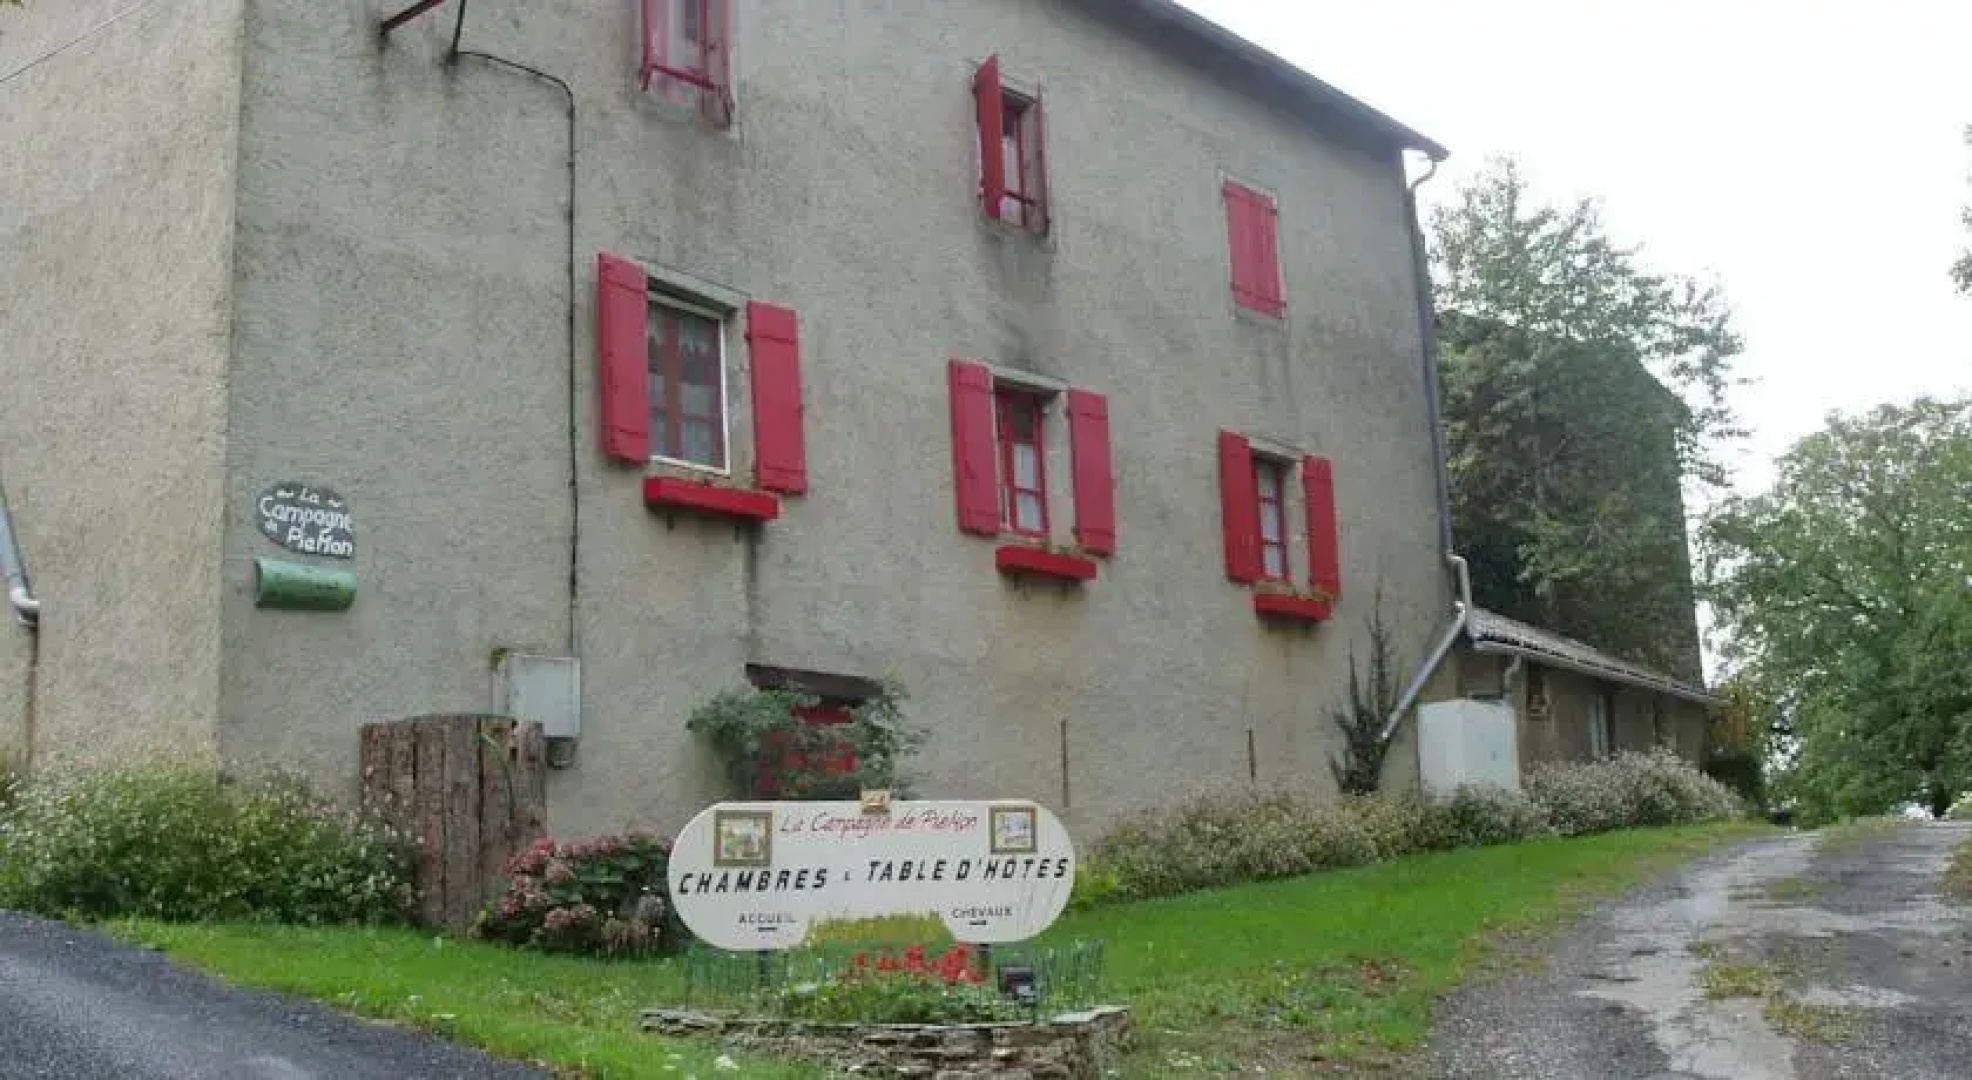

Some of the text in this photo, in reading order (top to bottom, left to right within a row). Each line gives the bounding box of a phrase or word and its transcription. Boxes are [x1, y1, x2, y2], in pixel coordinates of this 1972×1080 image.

[299, 487, 320, 504] La
[678, 867, 828, 895] CHAMBRES
[868, 858, 947, 882] TABLE
[739, 912, 797, 924] ACCUEIL
[952, 905, 1013, 918] CHEVAUX
